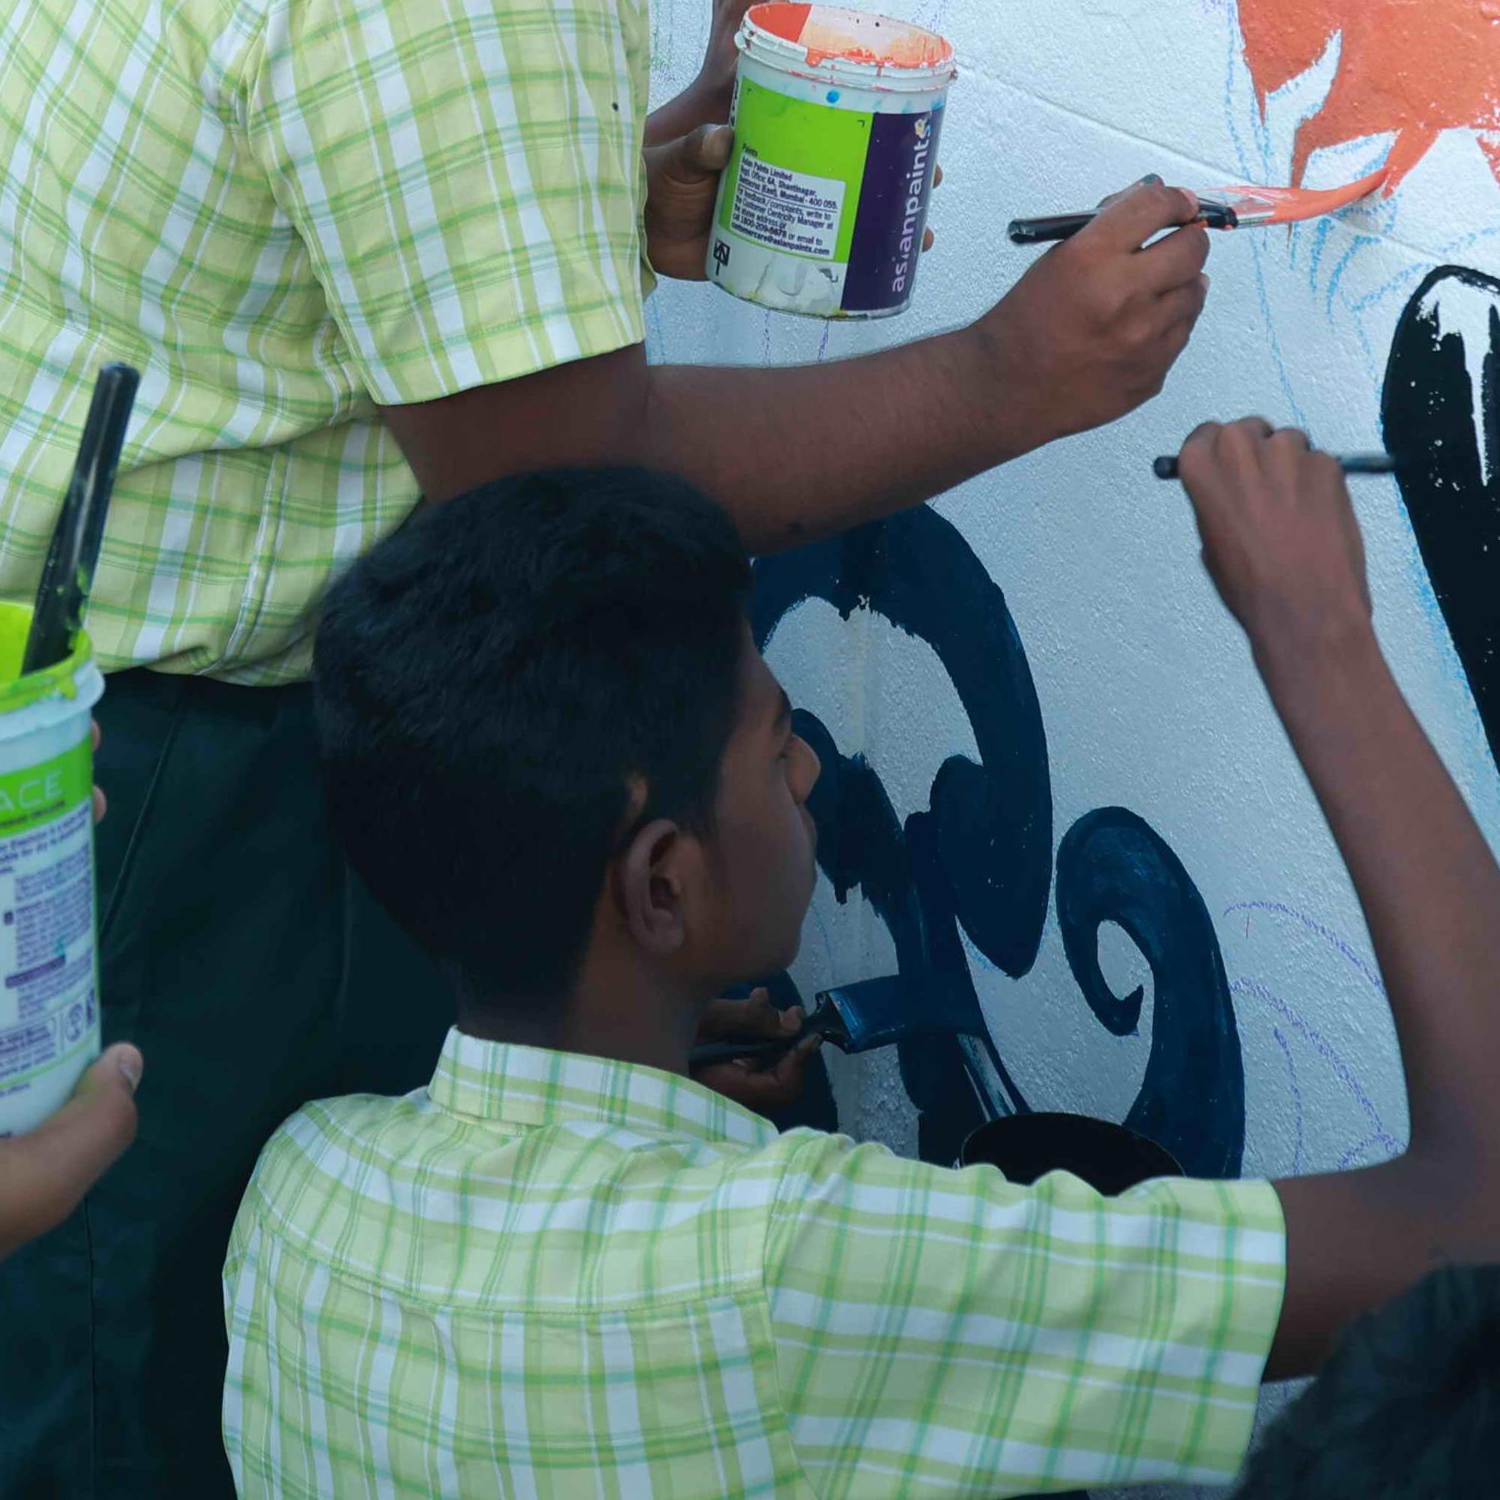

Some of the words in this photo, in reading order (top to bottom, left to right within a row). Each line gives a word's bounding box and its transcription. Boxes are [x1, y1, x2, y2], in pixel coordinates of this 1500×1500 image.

[754, 162, 769, 174] Paints
[770, 167, 793, 181] Limited
[780, 190, 805, 204] Mumbai
[743, 198, 767, 213] Customer
[797, 214, 825, 230] Manager
[826, 221, 834, 230] at
[806, 208, 823, 219] write
[824, 212, 832, 220] to
[891, 122, 932, 293] asianpaints
[756, 213, 779, 227] address
[797, 233, 815, 245] email
[815, 237, 824, 246] to
